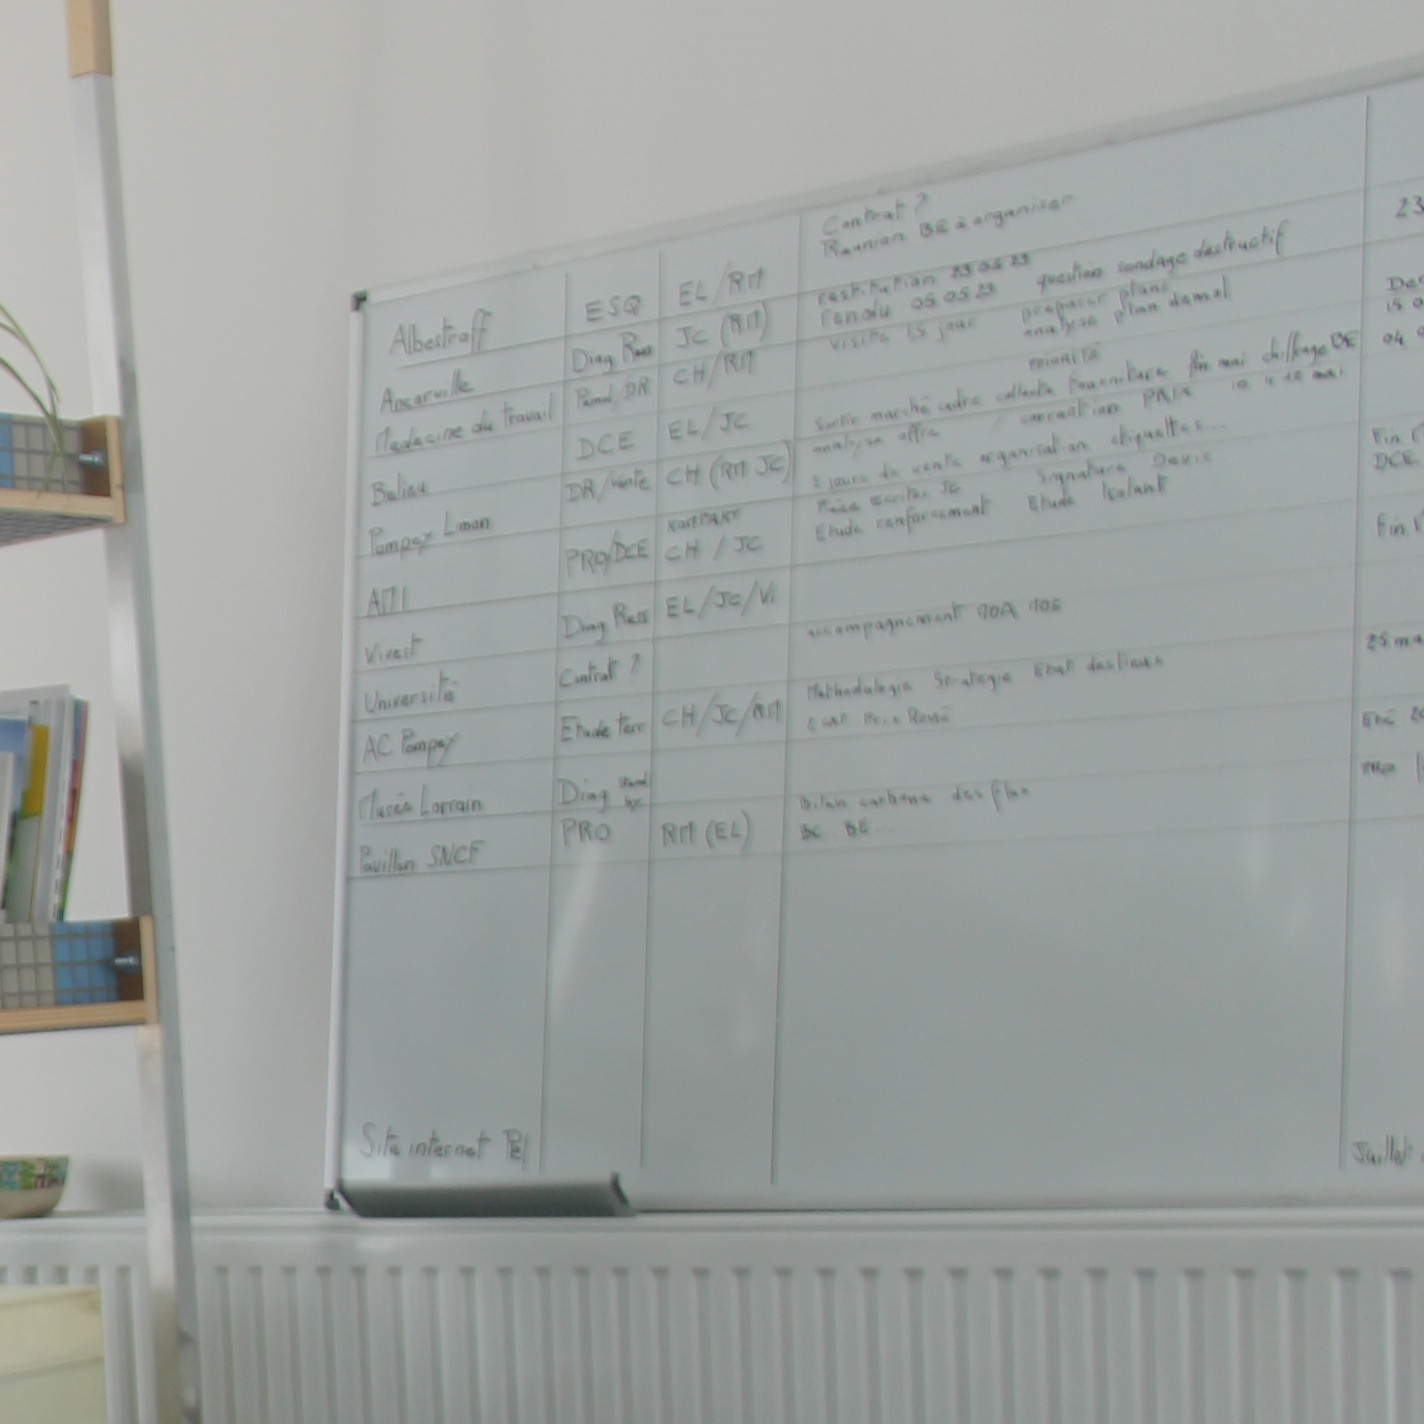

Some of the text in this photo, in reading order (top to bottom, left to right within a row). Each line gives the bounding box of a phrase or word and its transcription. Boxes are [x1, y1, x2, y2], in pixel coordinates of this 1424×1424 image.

[584, 294, 643, 323] ESQ
[388, 307, 493, 356] Albestroff
[574, 429, 635, 461] DCE
[560, 818, 612, 850] PRO
[361, 1121, 401, 1158] Site
[408, 1128, 492, 1160] internet
